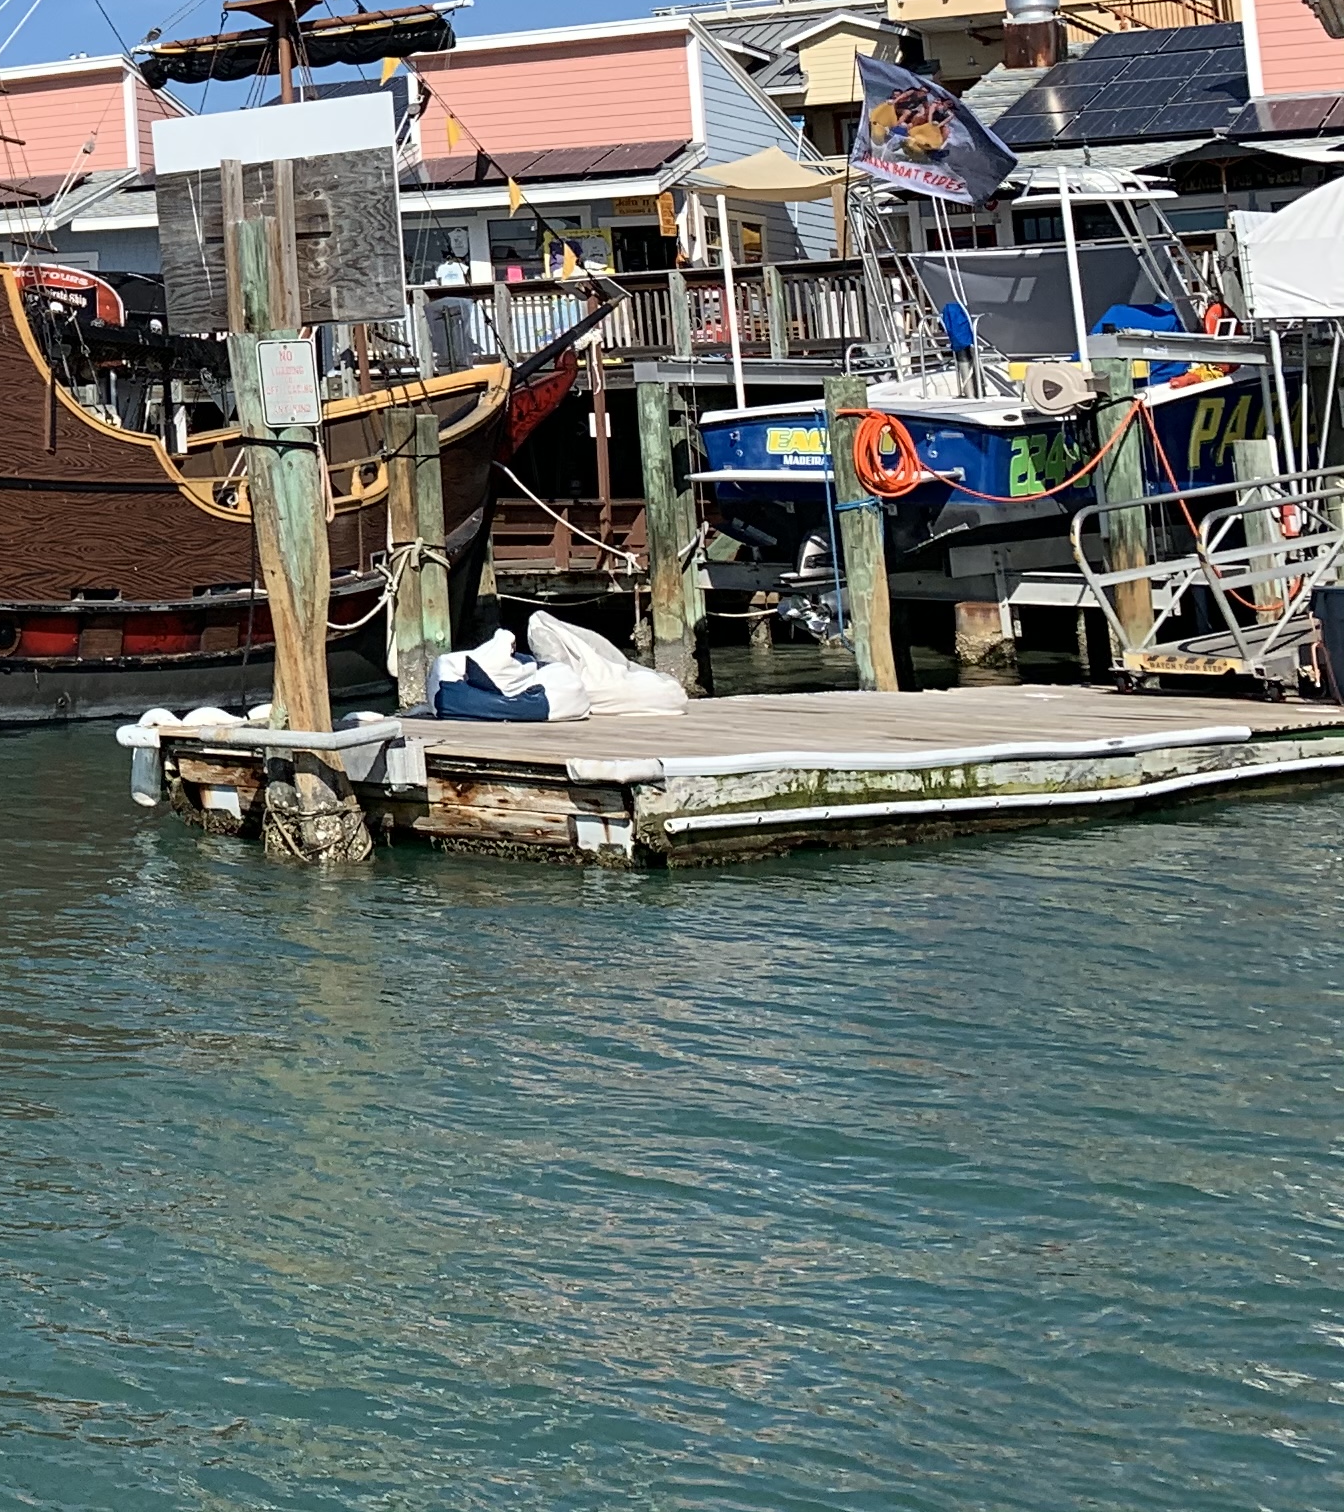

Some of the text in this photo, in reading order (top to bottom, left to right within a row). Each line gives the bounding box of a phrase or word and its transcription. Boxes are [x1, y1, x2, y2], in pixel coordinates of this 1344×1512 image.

[892, 162, 921, 180] BOAT
[923, 171, 966, 191] RIDES
[42, 271, 89, 286] TOURS
[279, 350, 293, 362] NO
[1149, 662, 1223, 672] WATCH YOUR STEP
